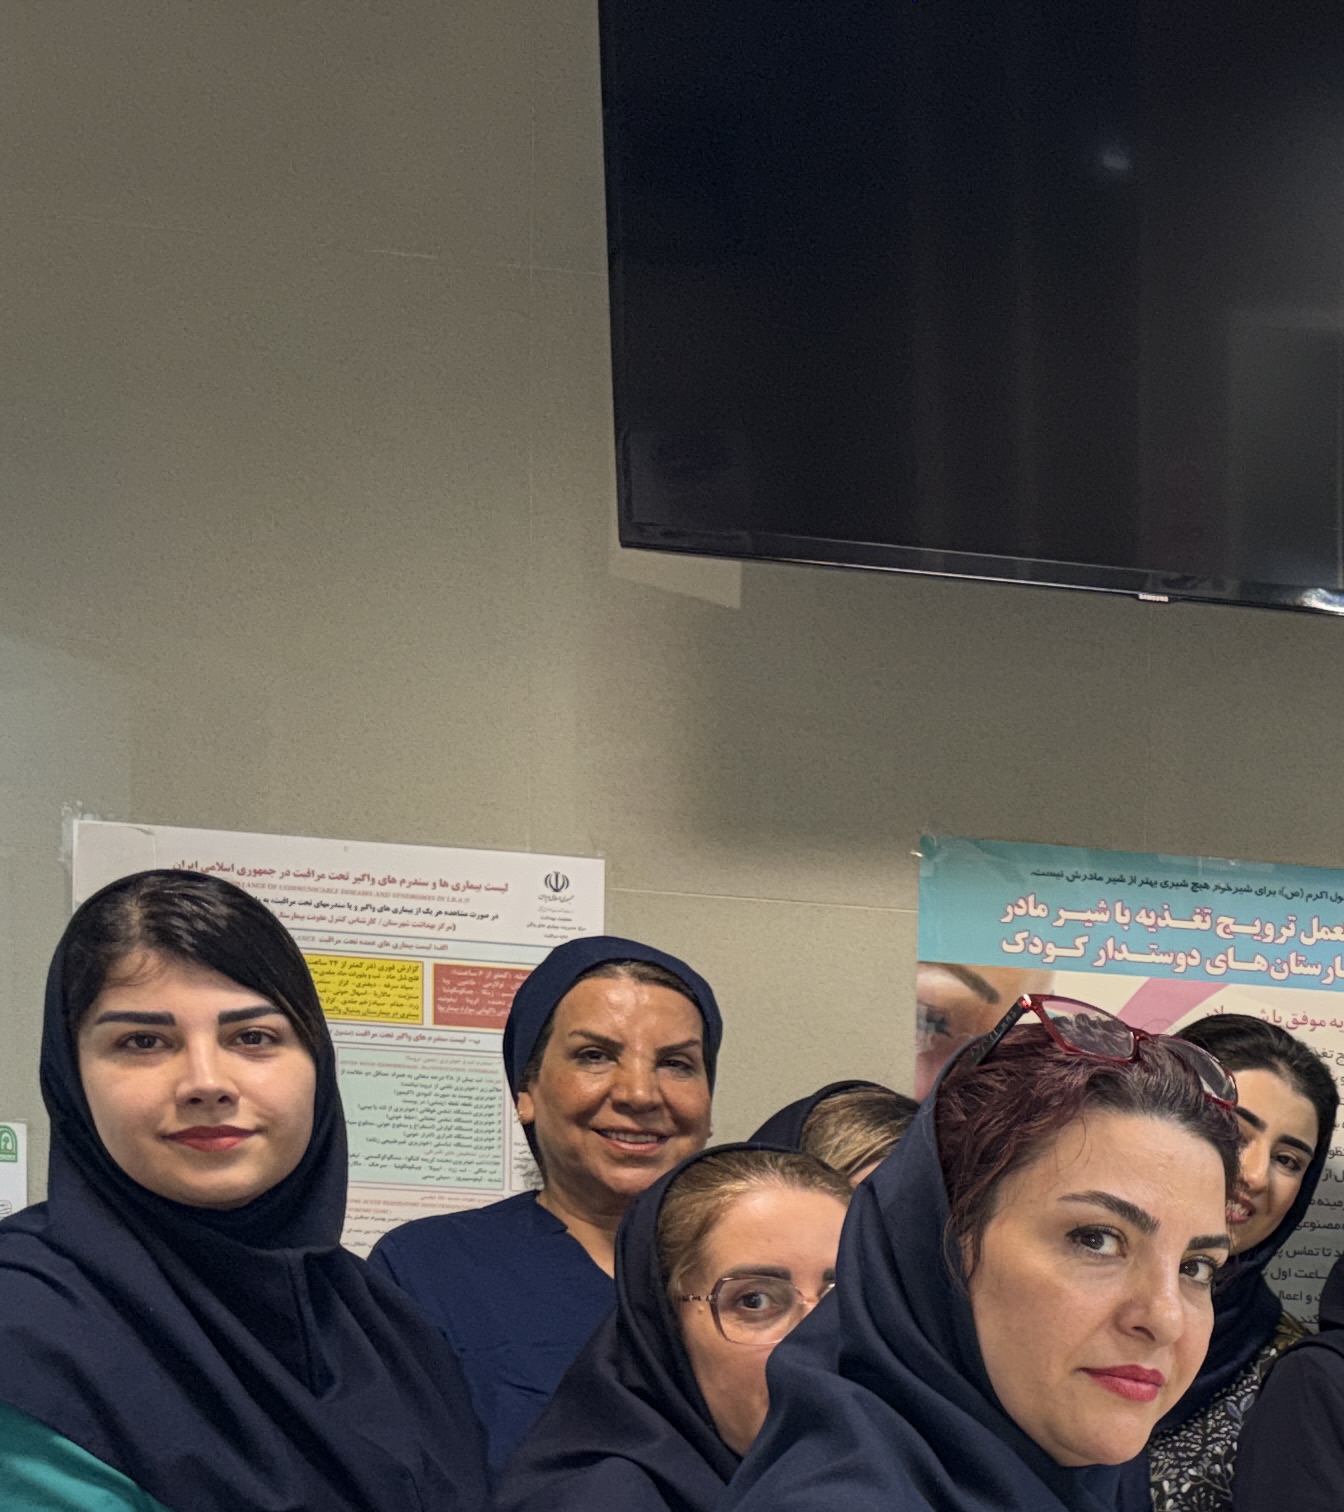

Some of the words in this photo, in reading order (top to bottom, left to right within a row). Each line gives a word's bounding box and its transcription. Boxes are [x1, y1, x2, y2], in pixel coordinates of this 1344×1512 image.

[1066, 872, 1103, 882] مادرش
[1105, 874, 1126, 885] شیر
[1128, 876, 1137, 885] از
[484, 882, 509, 894] لیست
[1159, 879, 1189, 889] شیری
[1190, 880, 1210, 892] هیچ
[1305, 891, 1328, 902] اکرم
[999, 892, 1049, 923] مادر
[1052, 900, 1111, 928] شیر
[1113, 899, 1131, 930] با
[1135, 903, 1214, 934] تغذیه
[1215, 914, 1297, 944] ترویج
[1001, 930, 1090, 964] کودک
[1092, 936, 1201, 974] دوستدار
[1285, 1011, 1327, 1032] موفق
[1322, 1168, 1333, 1181] از
[1286, 1247, 1320, 1258] تماس
[1322, 1246, 1332, 1257] تا
